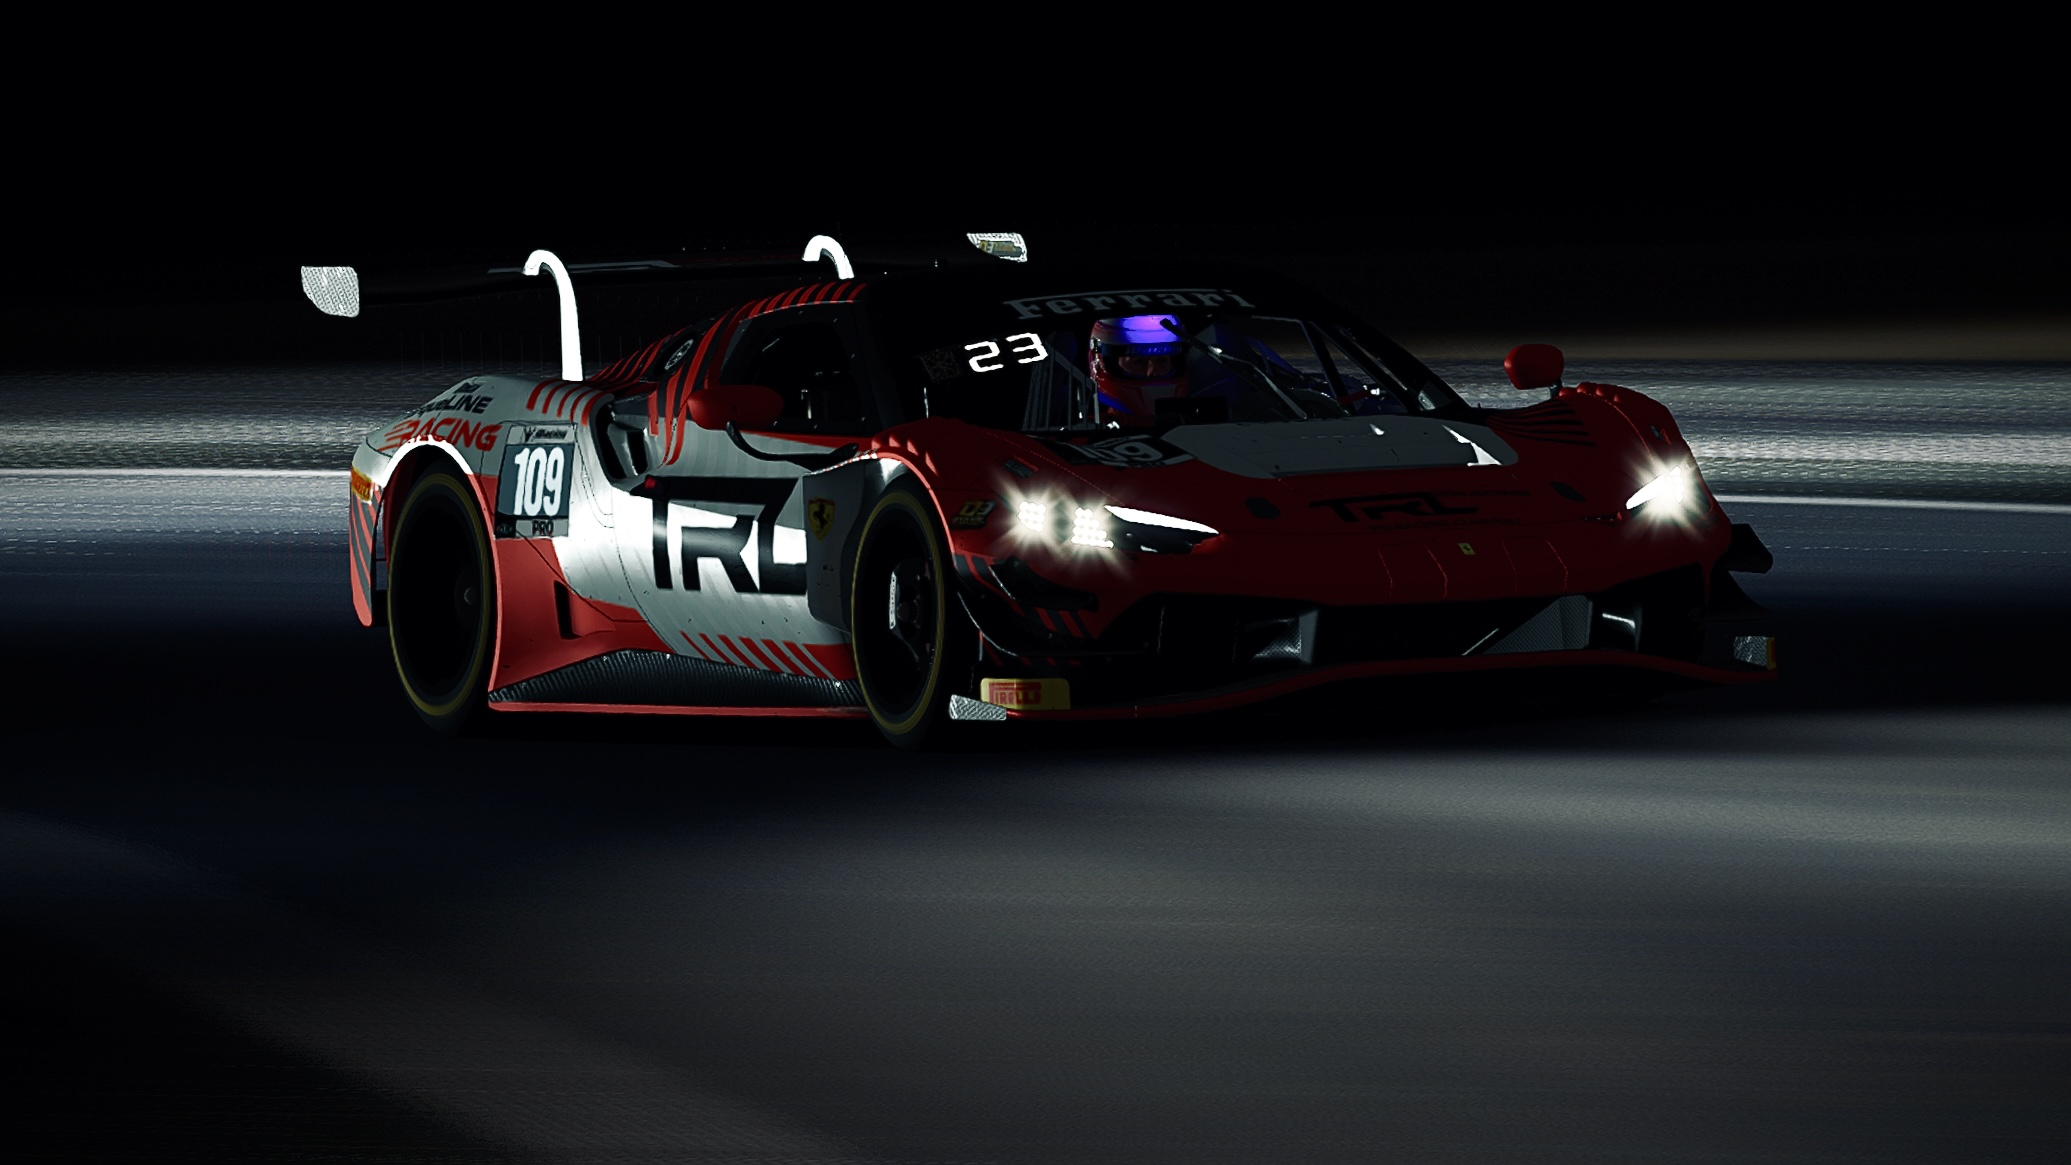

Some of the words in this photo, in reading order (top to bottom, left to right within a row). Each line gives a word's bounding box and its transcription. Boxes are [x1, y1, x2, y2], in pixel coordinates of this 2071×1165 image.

[1002, 289, 1256, 320] Ferrari
[964, 332, 1048, 373] 23
[377, 417, 503, 452] RACING
[513, 446, 565, 517] 109
[1309, 492, 1479, 522] TRL
[532, 519, 555, 536] PRO
[630, 475, 807, 595] TRL
